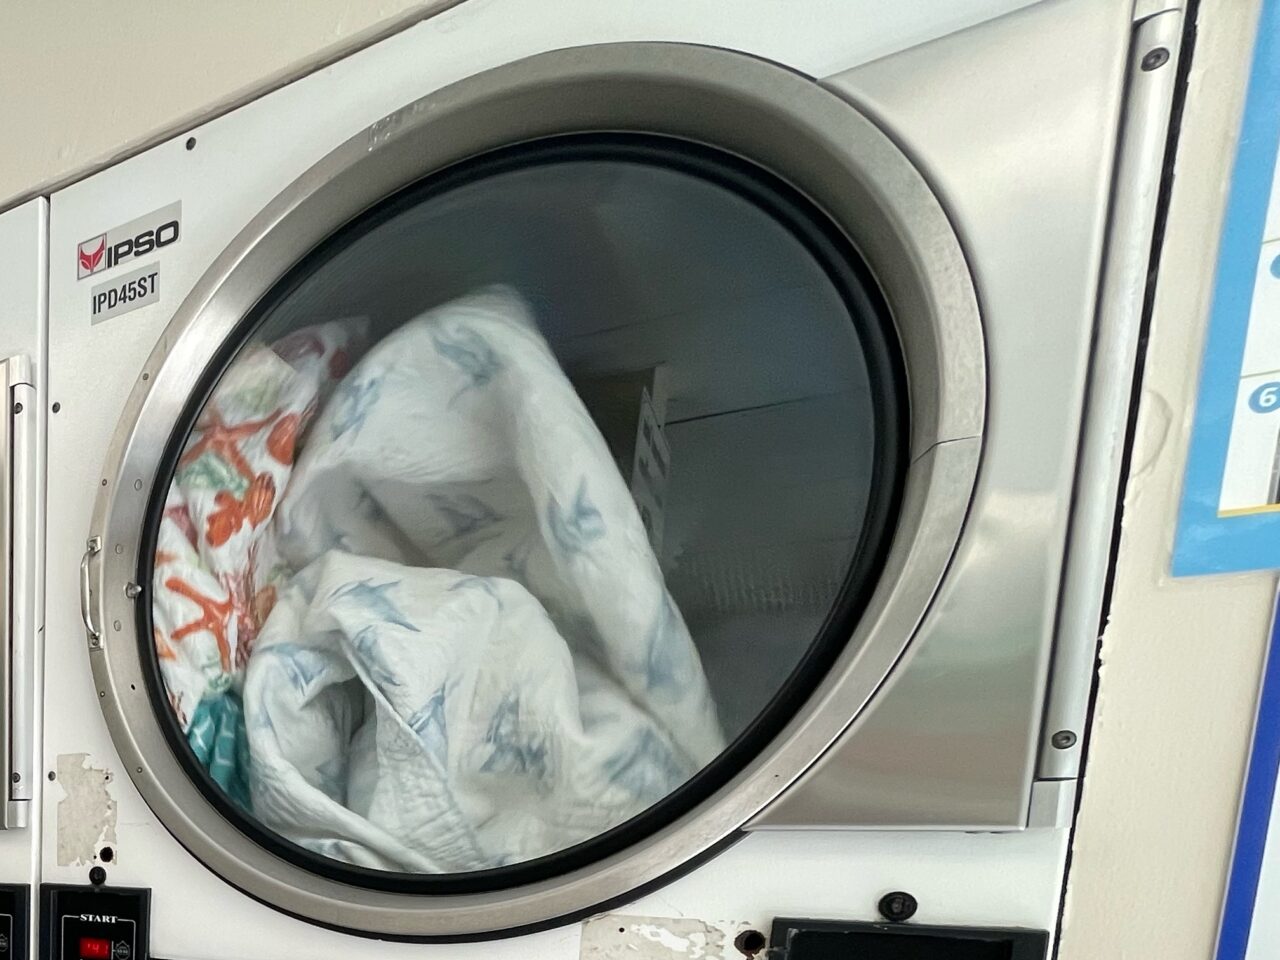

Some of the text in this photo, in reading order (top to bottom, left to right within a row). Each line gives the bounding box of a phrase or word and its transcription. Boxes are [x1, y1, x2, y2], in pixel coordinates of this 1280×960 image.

[107, 220, 179, 268] IPSO
[93, 272, 159, 315] IPD45ST
[1260, 387, 1279, 407] 6
[80, 913, 118, 924] START
